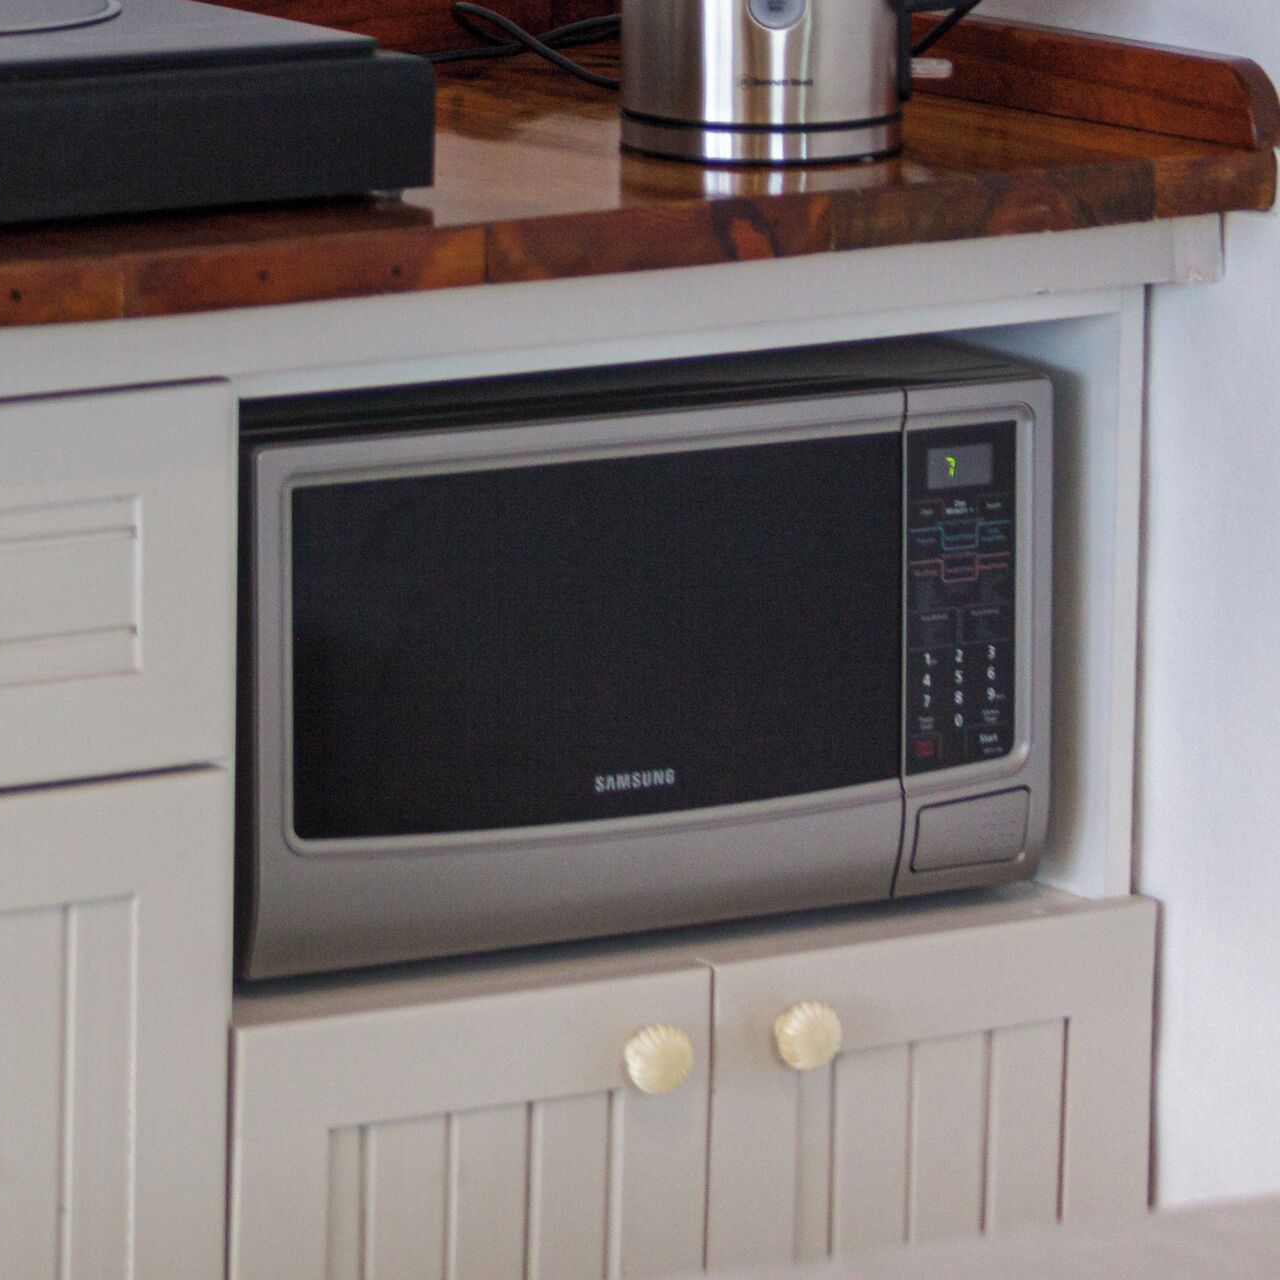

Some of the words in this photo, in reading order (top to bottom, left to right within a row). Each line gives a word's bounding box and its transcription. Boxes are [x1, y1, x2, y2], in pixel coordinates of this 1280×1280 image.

[955, 648, 964, 663] 2
[987, 644, 996, 660] 3
[955, 669, 963, 684] 5
[986, 665, 996, 680] 6
[923, 693, 931, 708] 7
[954, 690, 963, 705] 8
[986, 686, 996, 701] 9
[954, 713, 964, 728] 0
[594, 768, 675, 792] SAMSUNG
